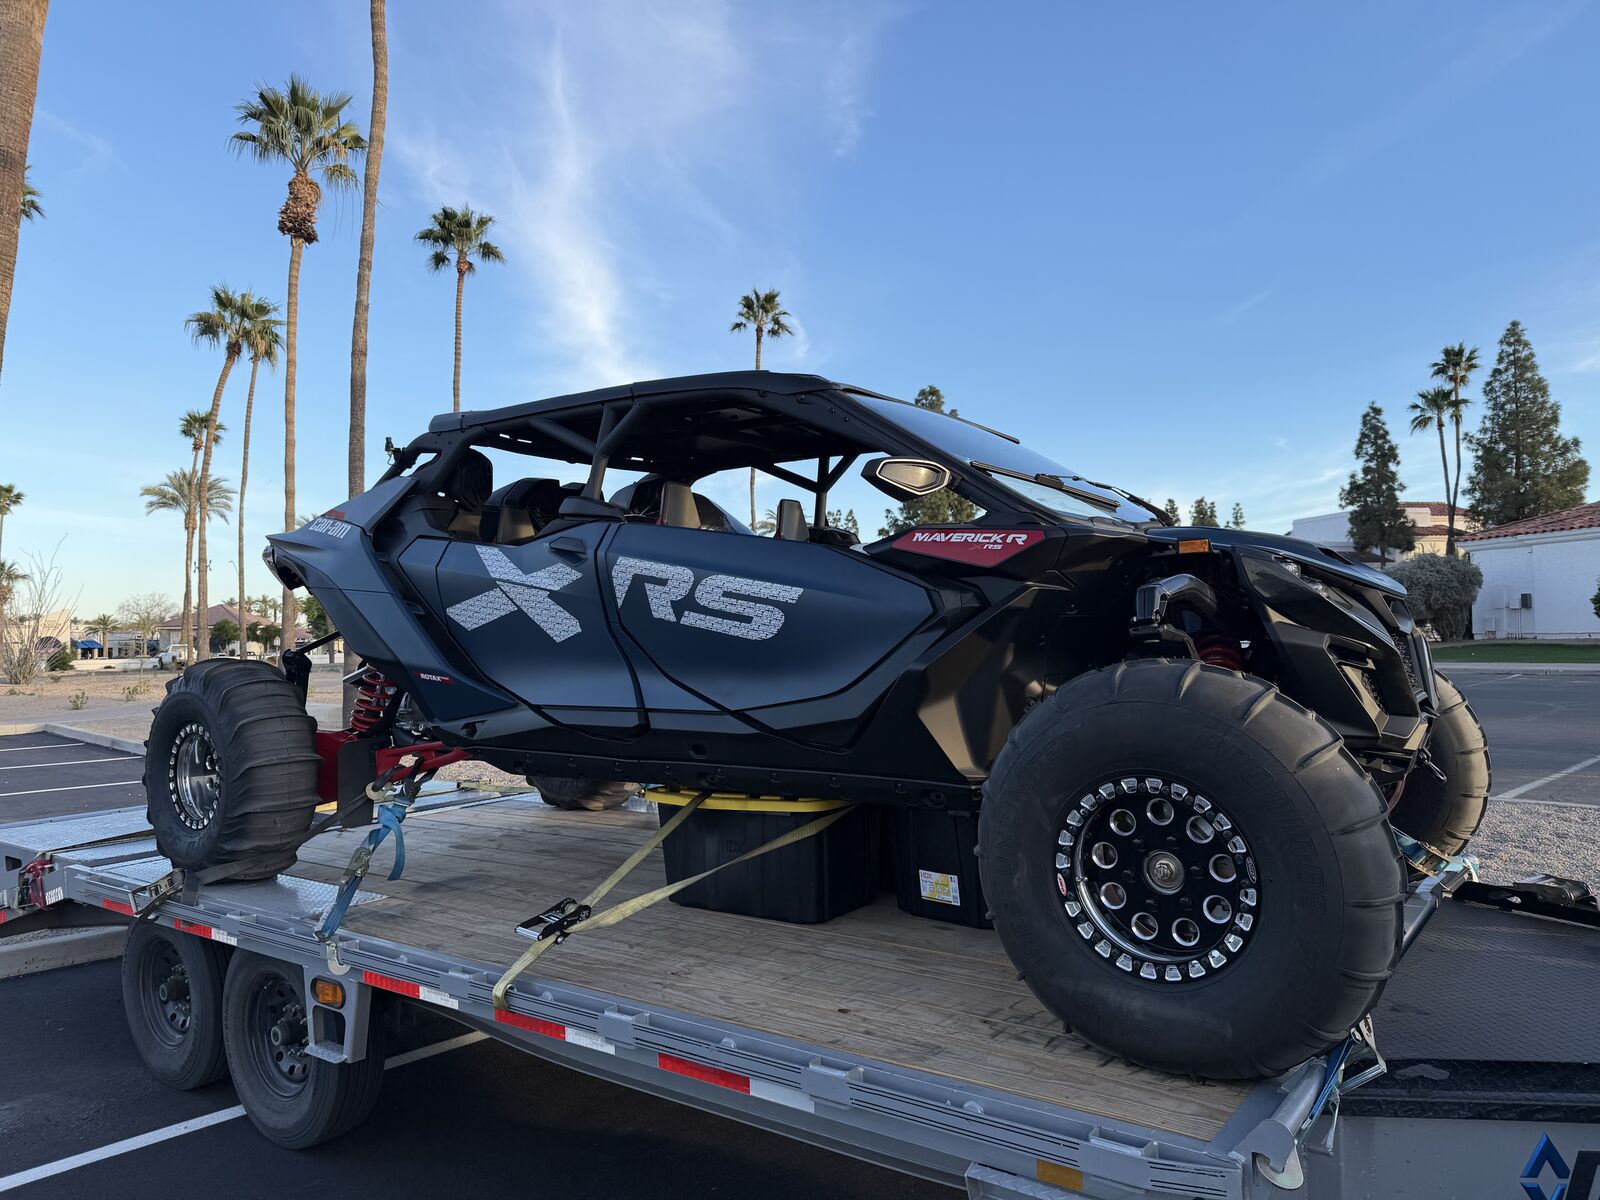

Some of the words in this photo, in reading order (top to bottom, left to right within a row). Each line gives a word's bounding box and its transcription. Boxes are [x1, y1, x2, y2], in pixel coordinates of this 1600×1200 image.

[912, 533, 1006, 543] MAVERICK
[1007, 533, 1028, 545] R
[420, 673, 442, 682] ROTAX
